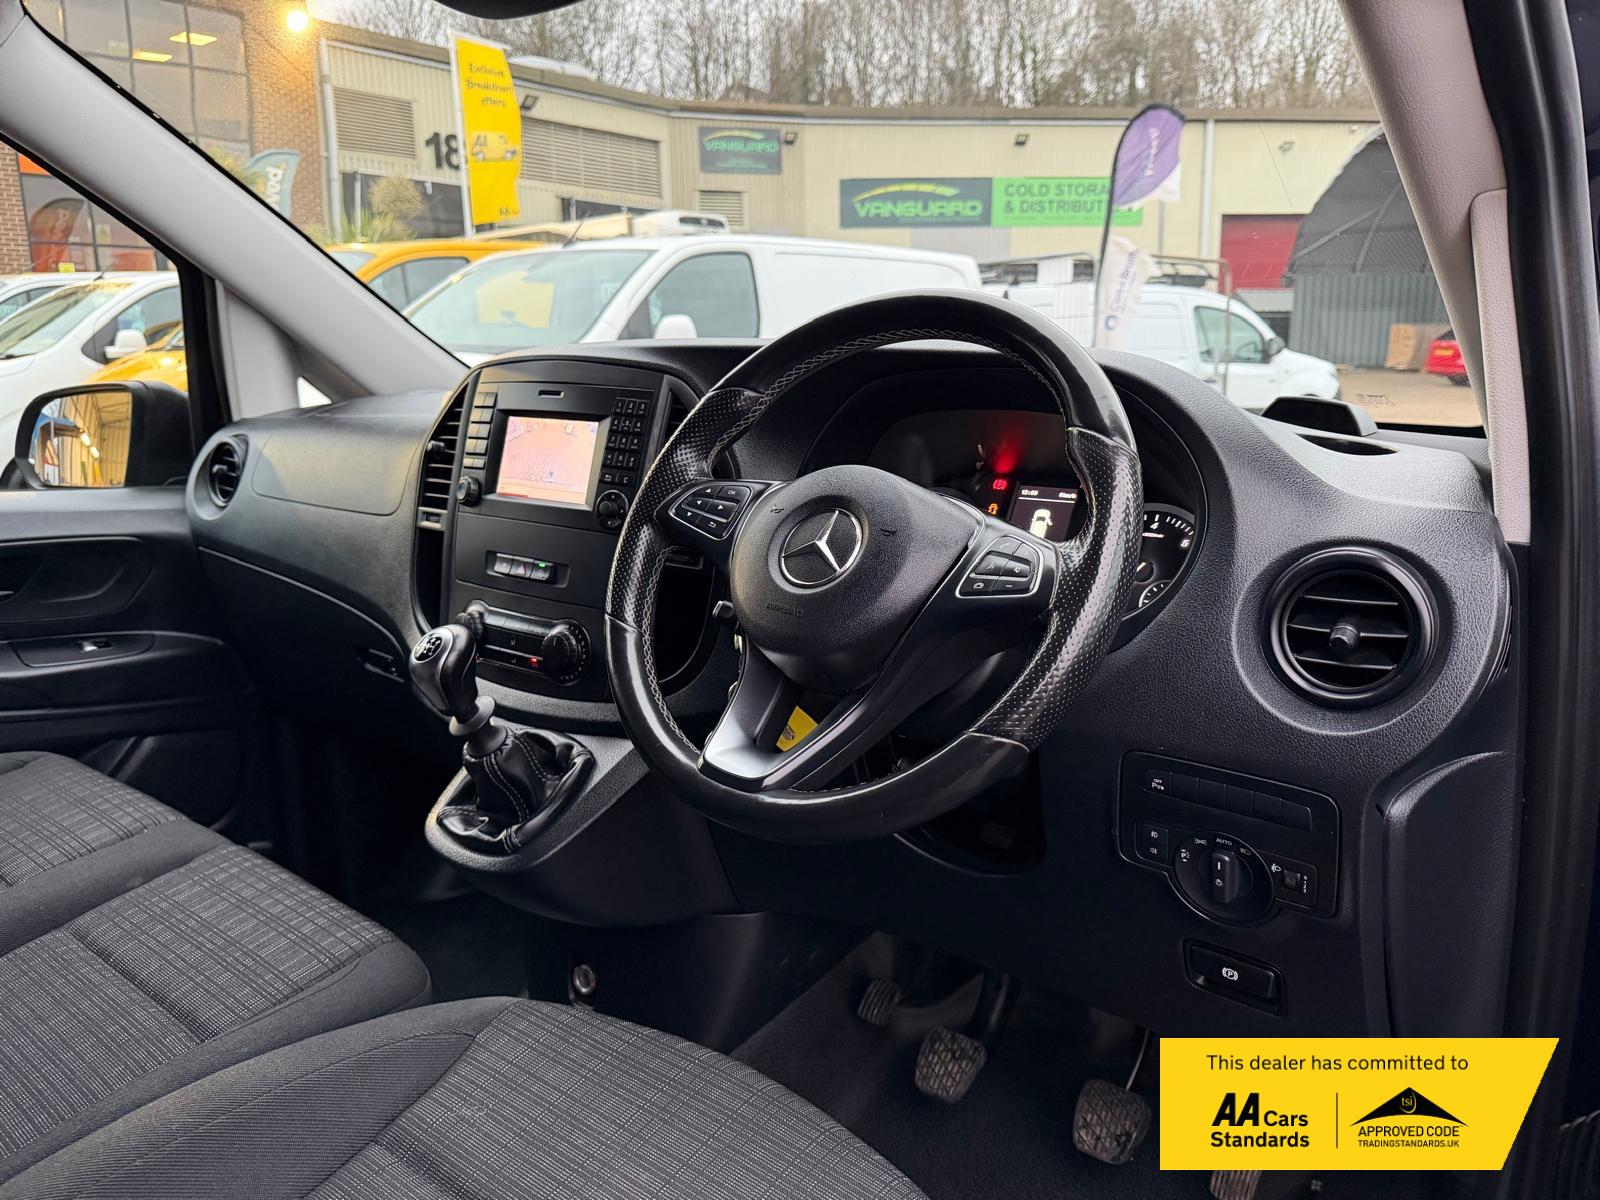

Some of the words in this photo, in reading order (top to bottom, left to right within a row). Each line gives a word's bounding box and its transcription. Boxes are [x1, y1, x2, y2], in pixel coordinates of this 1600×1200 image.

[425, 132, 460, 170] 18
[704, 138, 780, 153] VANGUARD
[1003, 183, 1050, 198] COLD
[1055, 183, 1110, 197] STORA
[854, 199, 984, 219] VANGUARD
[1003, 199, 1014, 214] &
[1150, 522, 1159, 530] 4
